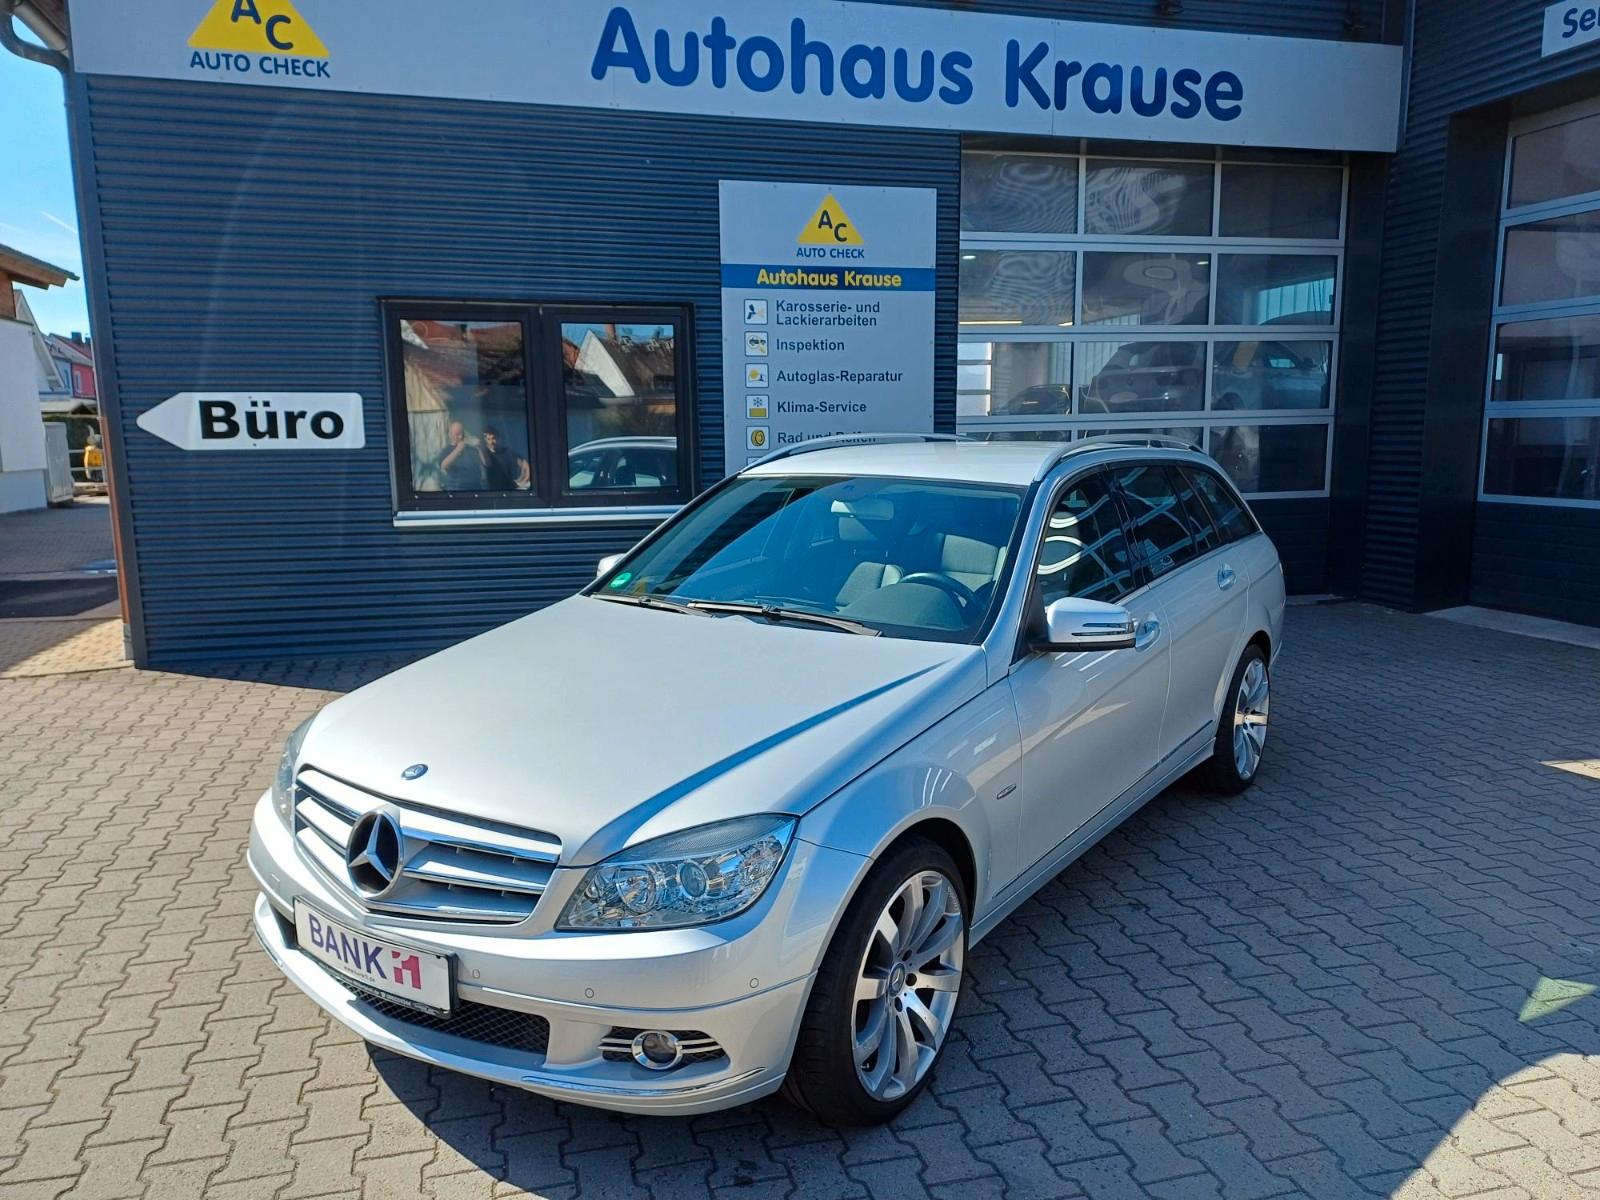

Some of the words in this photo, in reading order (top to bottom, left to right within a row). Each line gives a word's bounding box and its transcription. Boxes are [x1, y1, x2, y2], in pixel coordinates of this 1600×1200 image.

[190, 51, 251, 72] AUTO
[258, 56, 331, 78] CHECK
[591, 6, 973, 105] Autohaus
[1004, 39, 1243, 121] Krause
[796, 248, 826, 258] AUTO
[829, 249, 865, 259] CHECK
[757, 268, 839, 286] Autohaus
[844, 270, 902, 287] Krause
[776, 300, 852, 313] Karosserie-
[856, 302, 880, 313] und
[776, 314, 877, 327] Lackierarbeiten
[776, 338, 845, 352] Inspektion
[776, 370, 903, 384] Autoglas-Reparatur
[777, 401, 867, 413] Klima-Service
[199, 399, 345, 440] Büro
[777, 431, 803, 444] Rad
[308, 912, 387, 980] BANK
